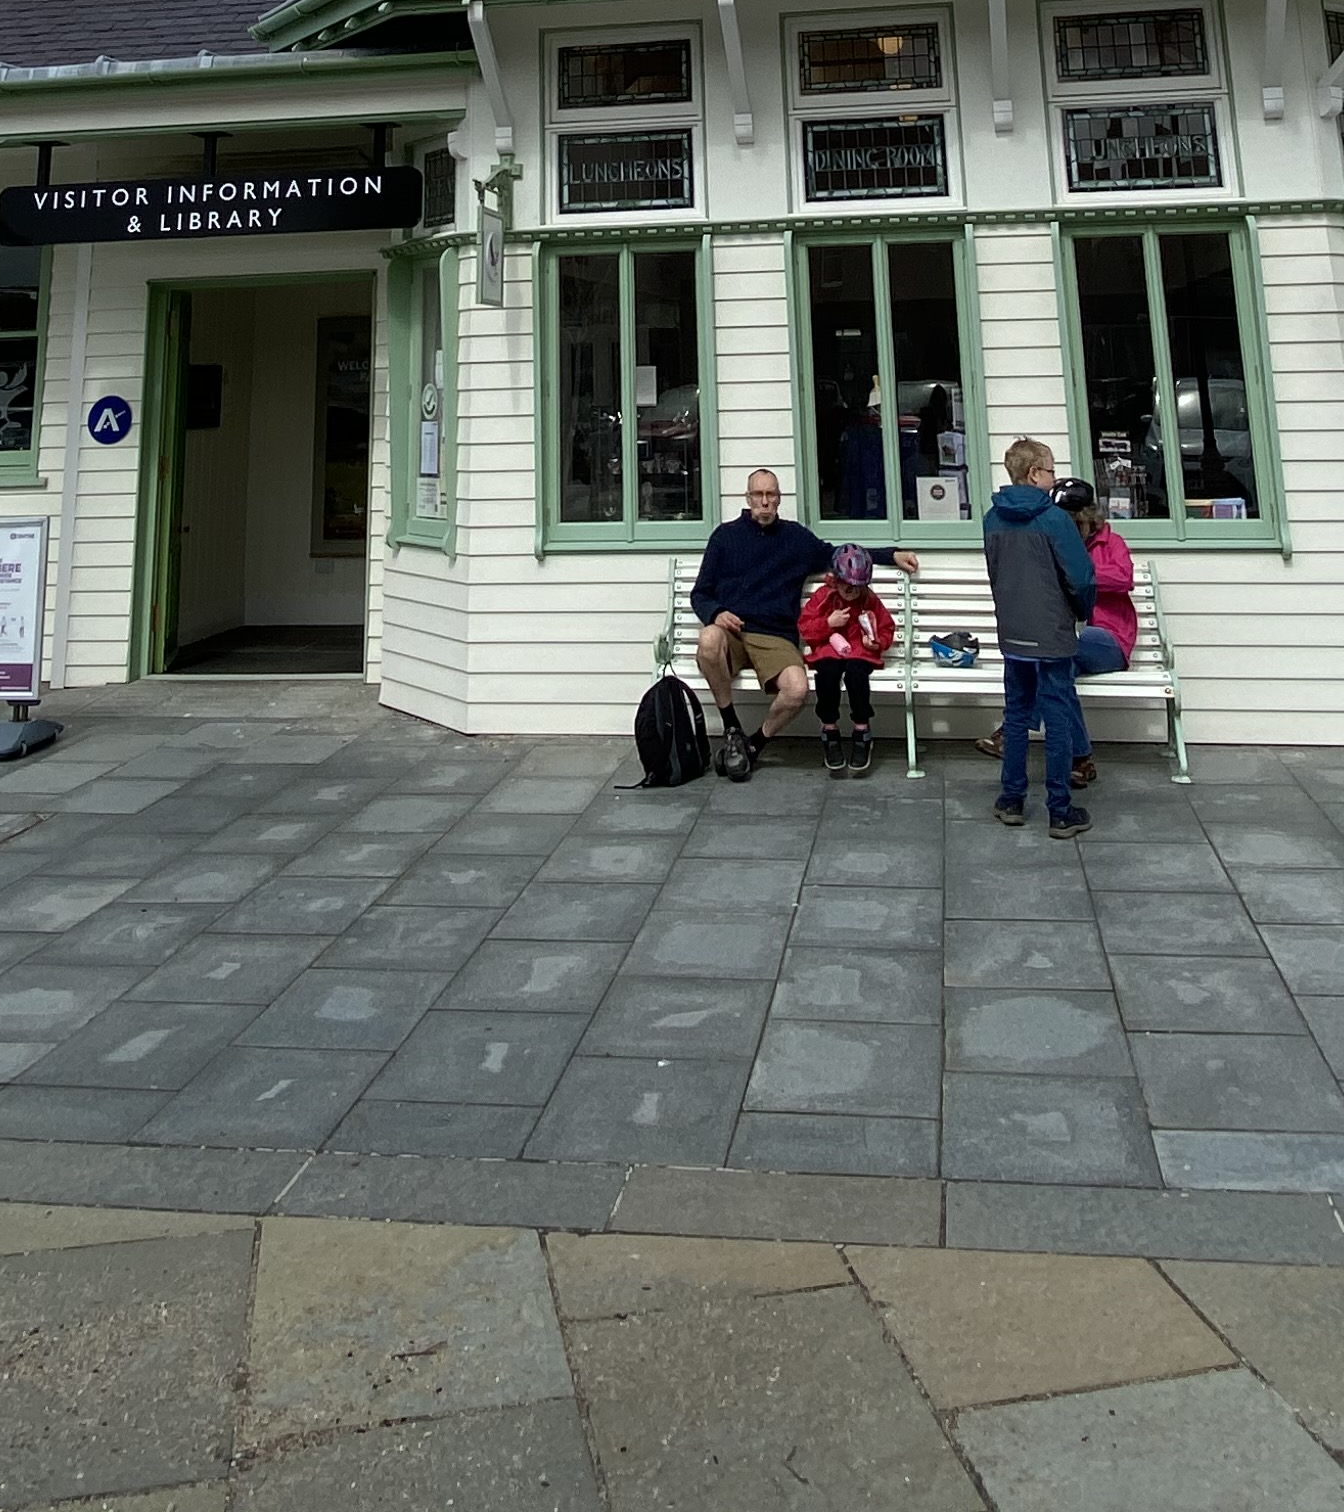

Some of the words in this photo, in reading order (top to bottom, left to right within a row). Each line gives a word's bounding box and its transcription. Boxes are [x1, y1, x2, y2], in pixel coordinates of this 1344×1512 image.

[815, 147, 880, 171] DINING
[885, 144, 936, 169] ROOM
[1077, 135, 1207, 162] LUNCHEONS
[570, 158, 684, 184] LUNCHEONS
[34, 187, 150, 209] VISITOR
[167, 176, 383, 204] INFORMATION
[127, 216, 142, 233] &
[161, 208, 283, 232] LIBRARY
